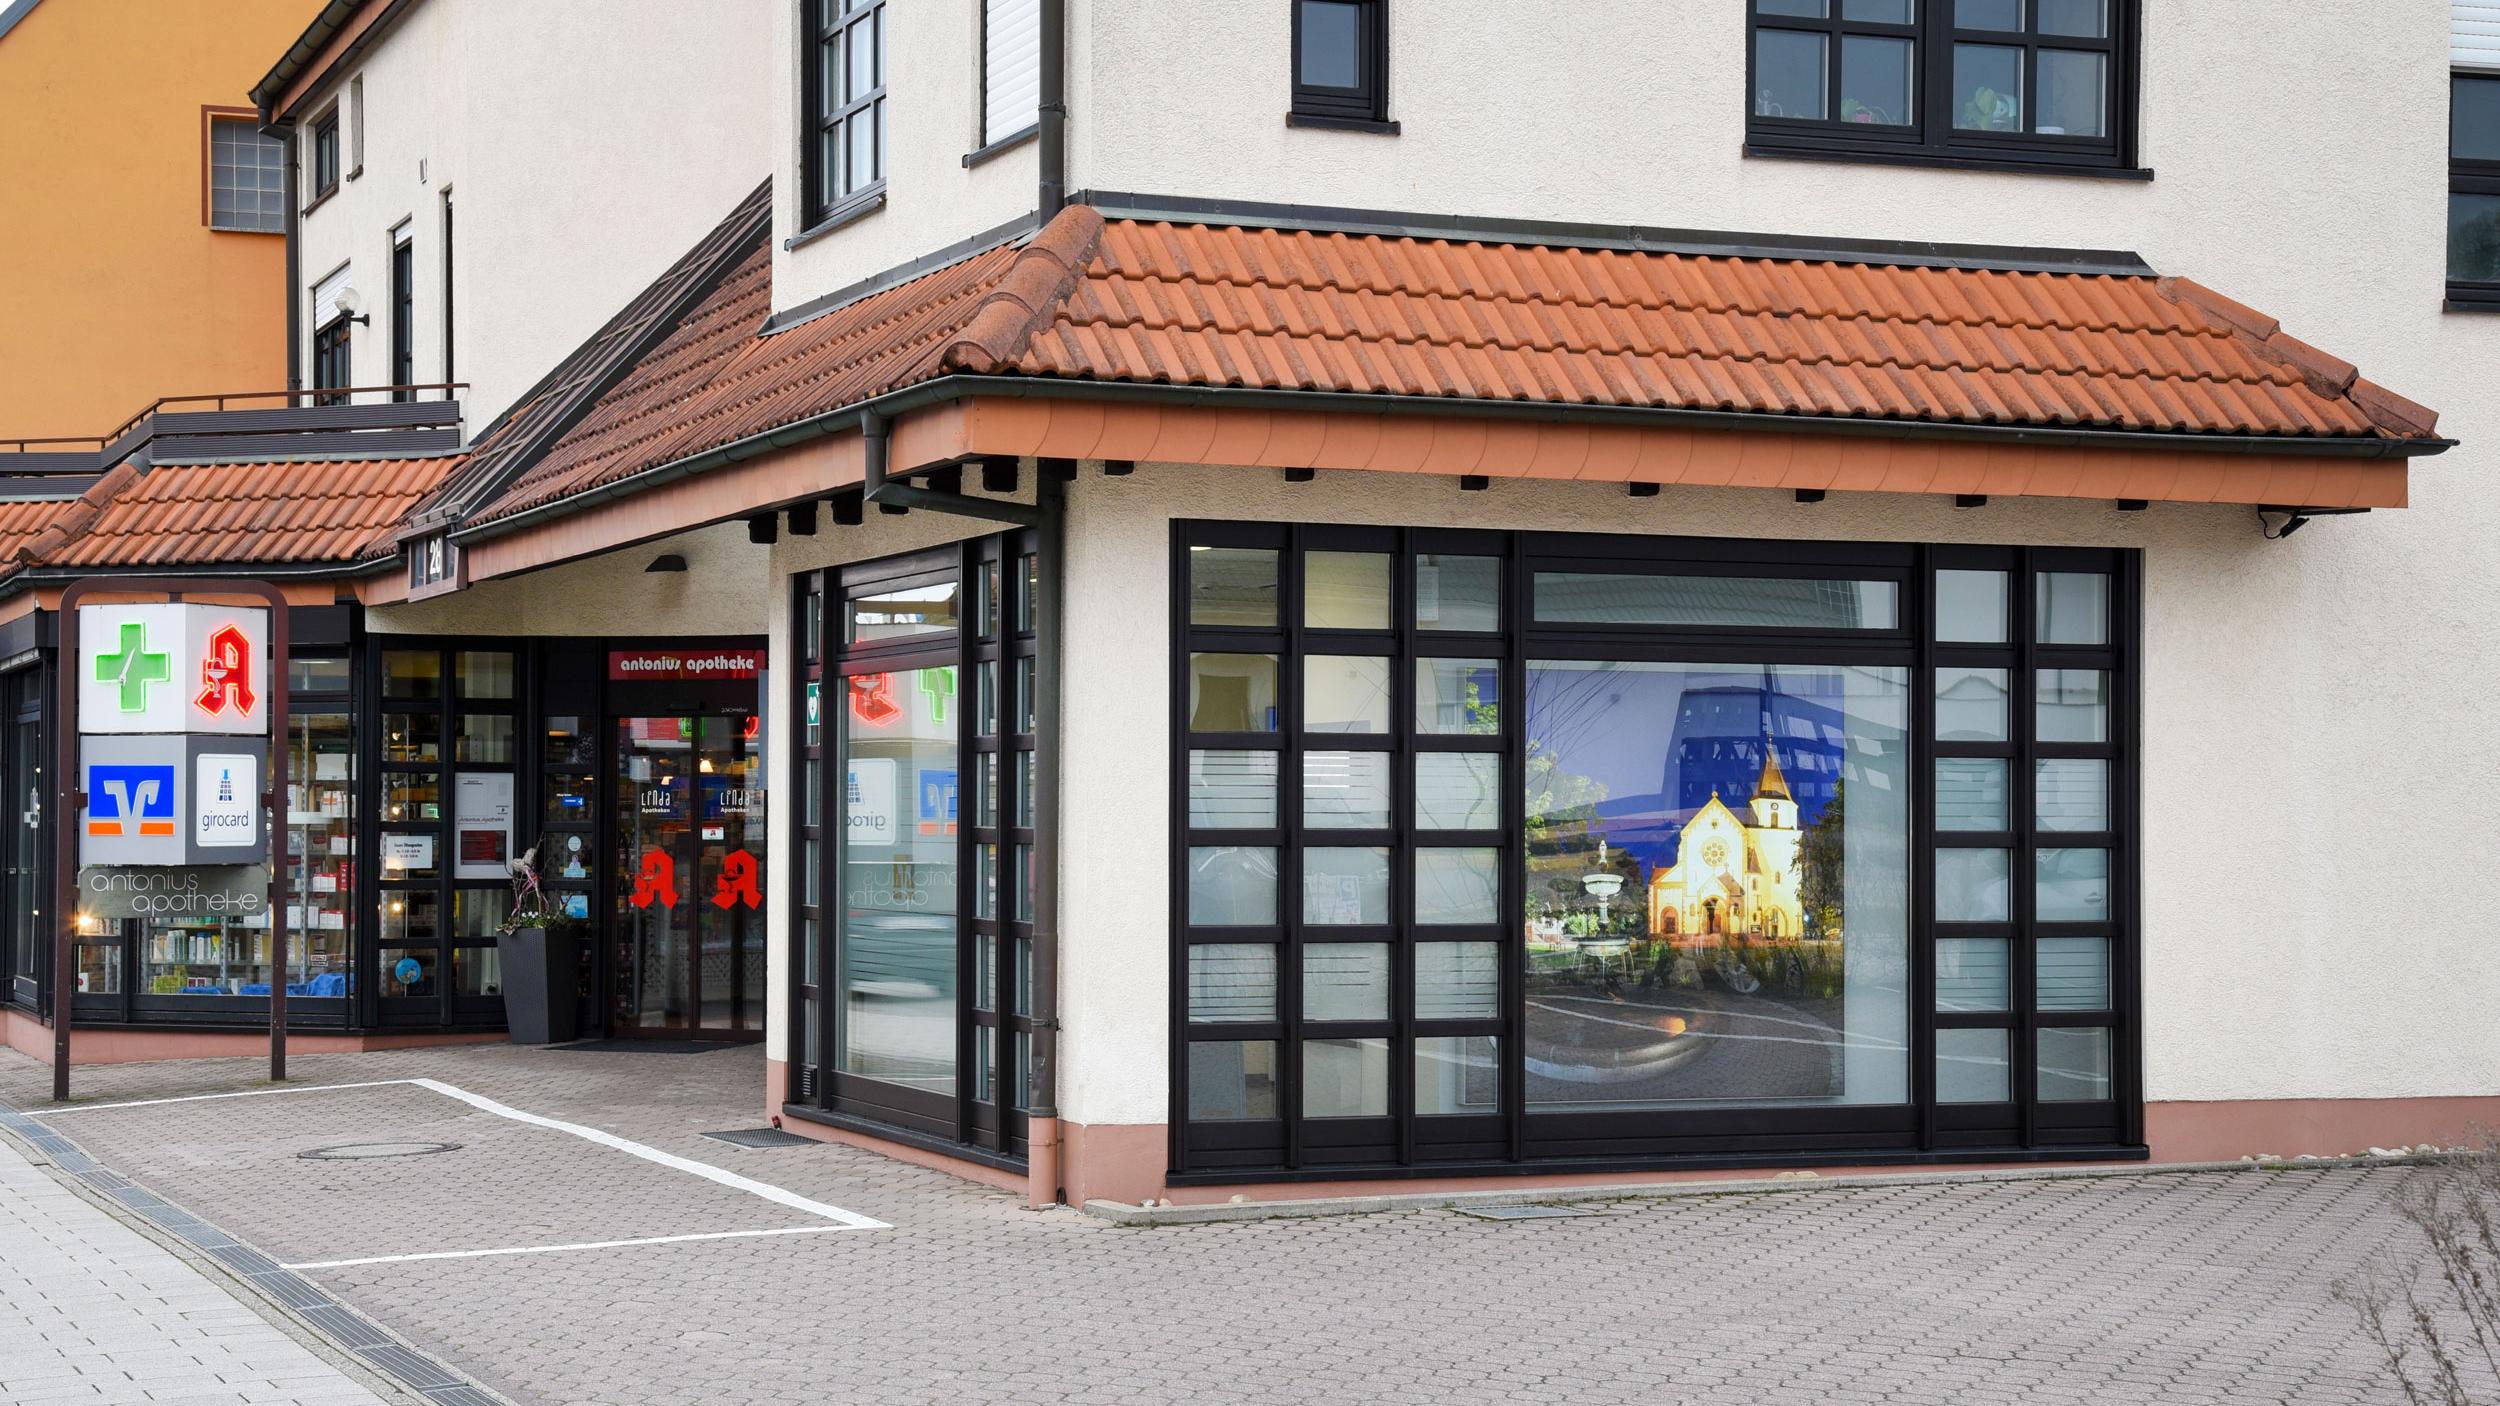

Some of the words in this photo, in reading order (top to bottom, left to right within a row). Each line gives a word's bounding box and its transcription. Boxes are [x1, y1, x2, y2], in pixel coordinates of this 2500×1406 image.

[430, 538, 441, 575] 28
[620, 655, 681, 671] antonius
[686, 655, 755, 673] apotheke
[202, 810, 249, 831] girocard
[91, 869, 199, 892] antonius
[132, 889, 258, 917] apotheke
